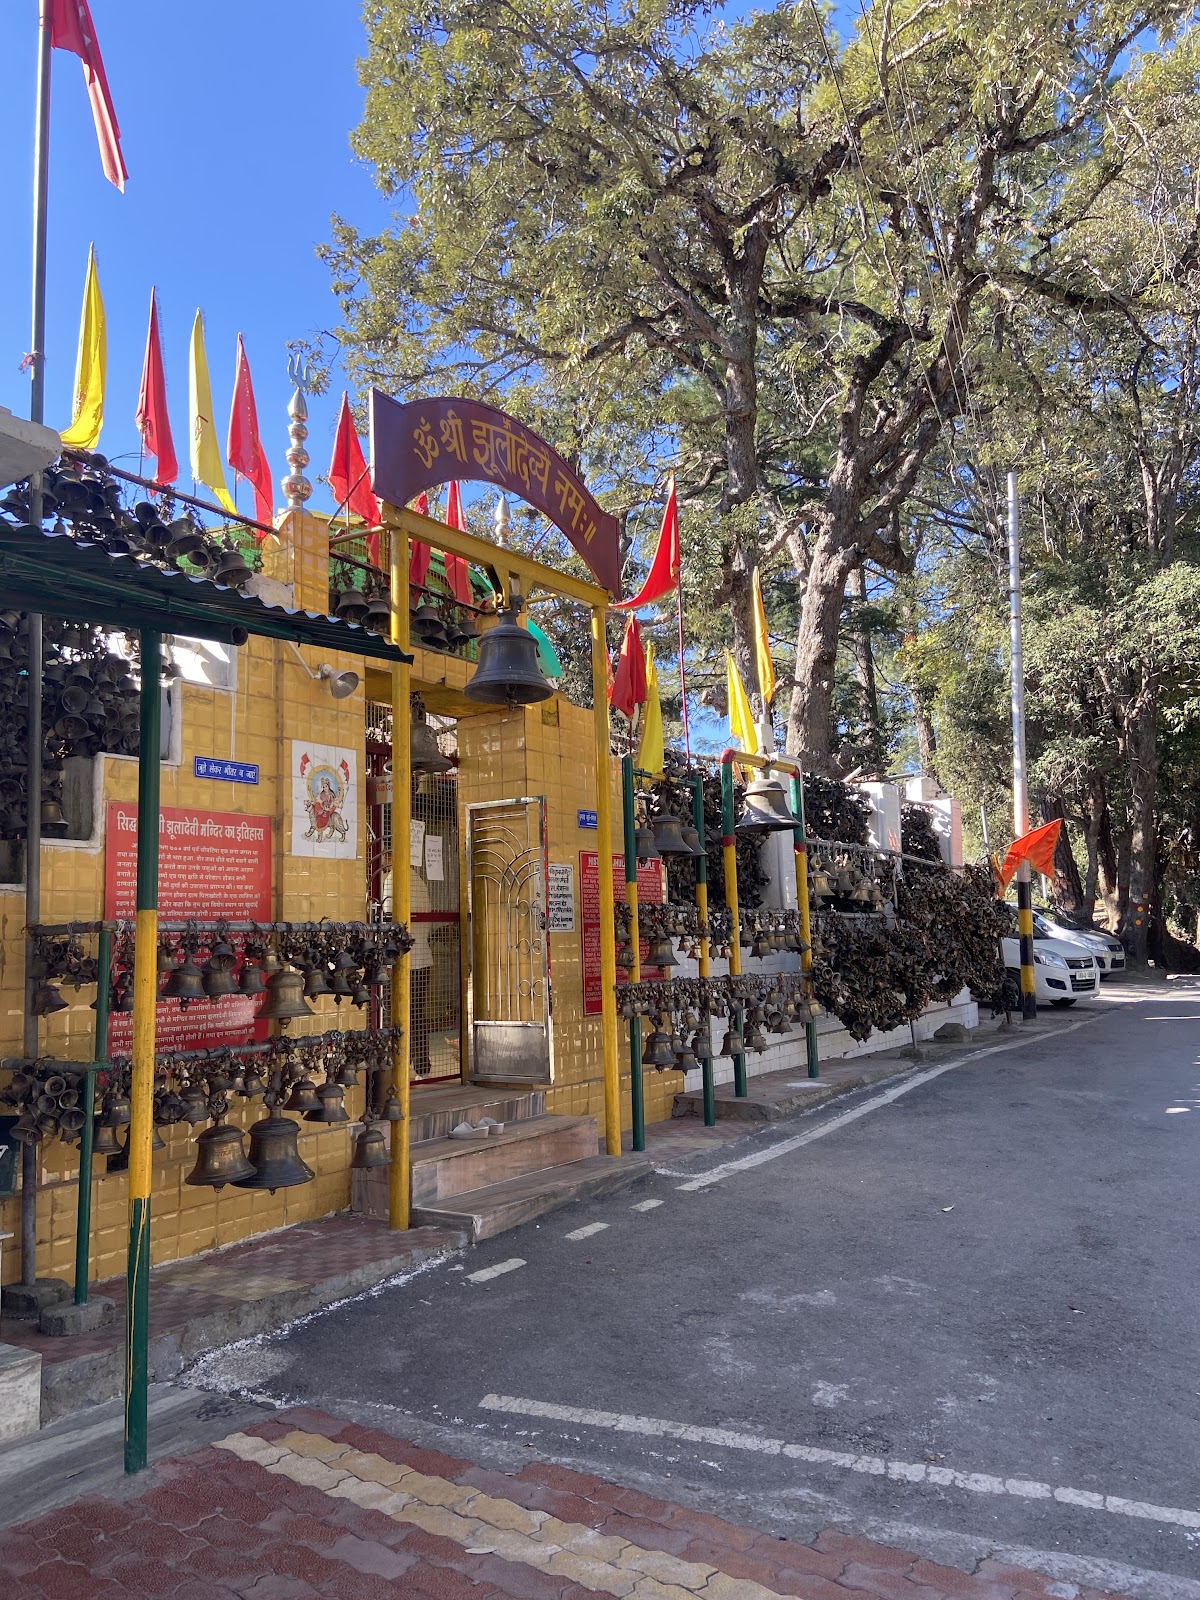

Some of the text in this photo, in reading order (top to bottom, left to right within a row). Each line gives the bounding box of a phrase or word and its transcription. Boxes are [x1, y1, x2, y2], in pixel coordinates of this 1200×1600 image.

[413, 416, 440, 469] ॐ
[440, 409, 468, 463] श्री
[166, 816, 199, 840] झूलादेवी
[200, 818, 223, 838] मन्दिर
[225, 825, 236, 839] का
[236, 821, 264, 841] इतिहास
